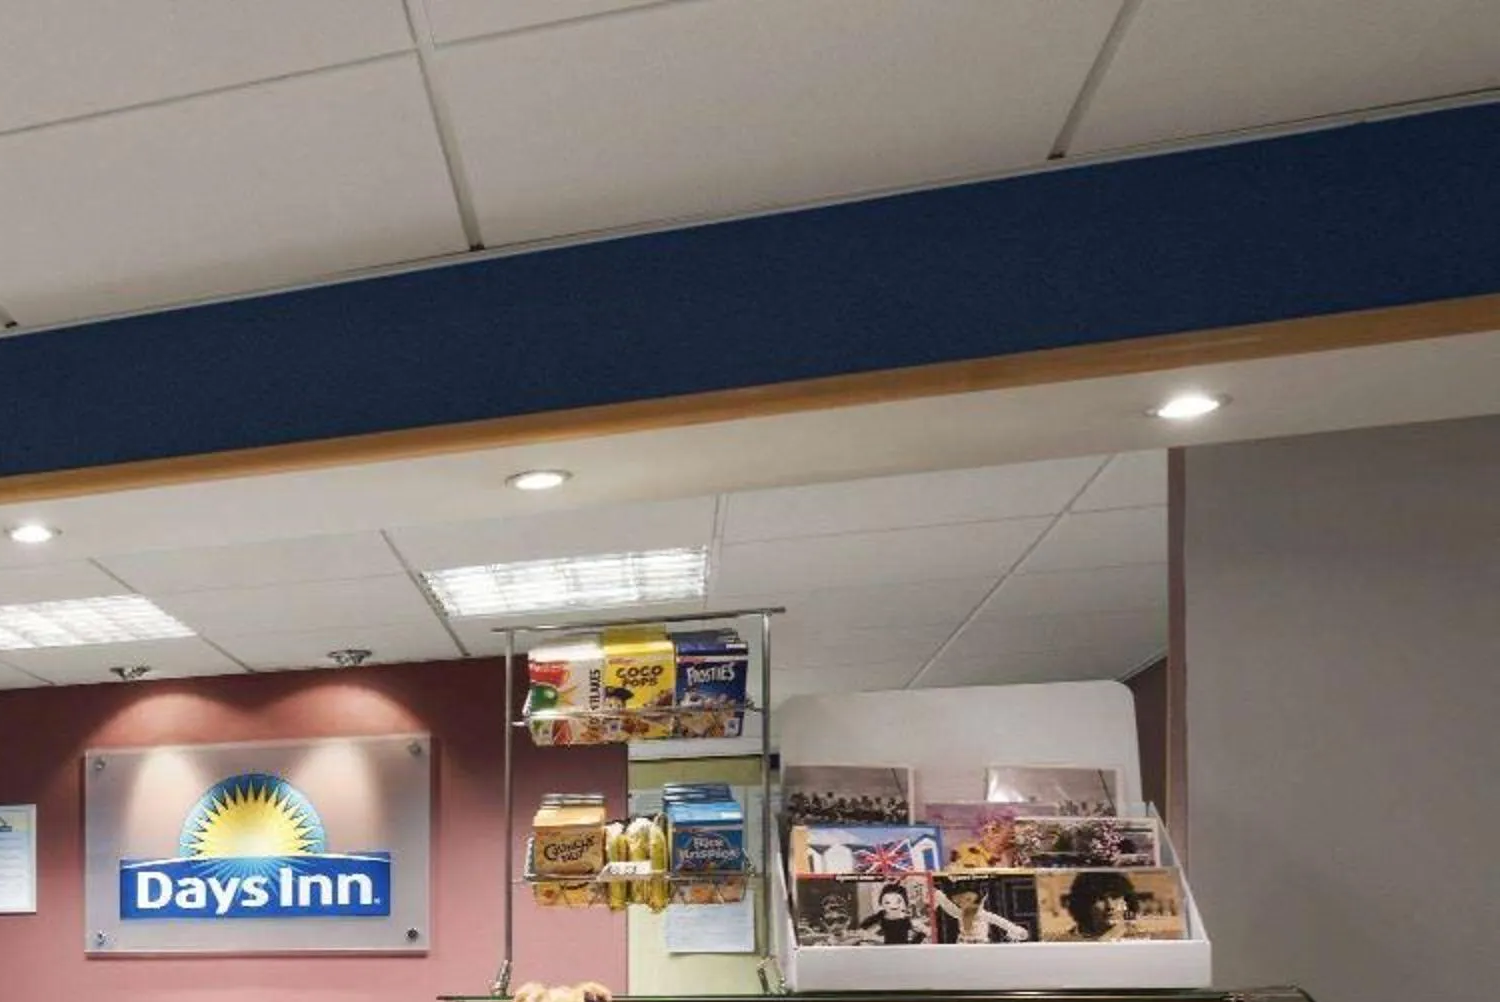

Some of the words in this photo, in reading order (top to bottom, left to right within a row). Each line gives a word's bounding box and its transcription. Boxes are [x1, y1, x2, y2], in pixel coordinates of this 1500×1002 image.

[616, 665, 663, 678] COCO
[686, 662, 736, 685] FROSTIES
[622, 678, 659, 687] POPS
[136, 871, 269, 915] Days
[279, 866, 373, 907] Inn
